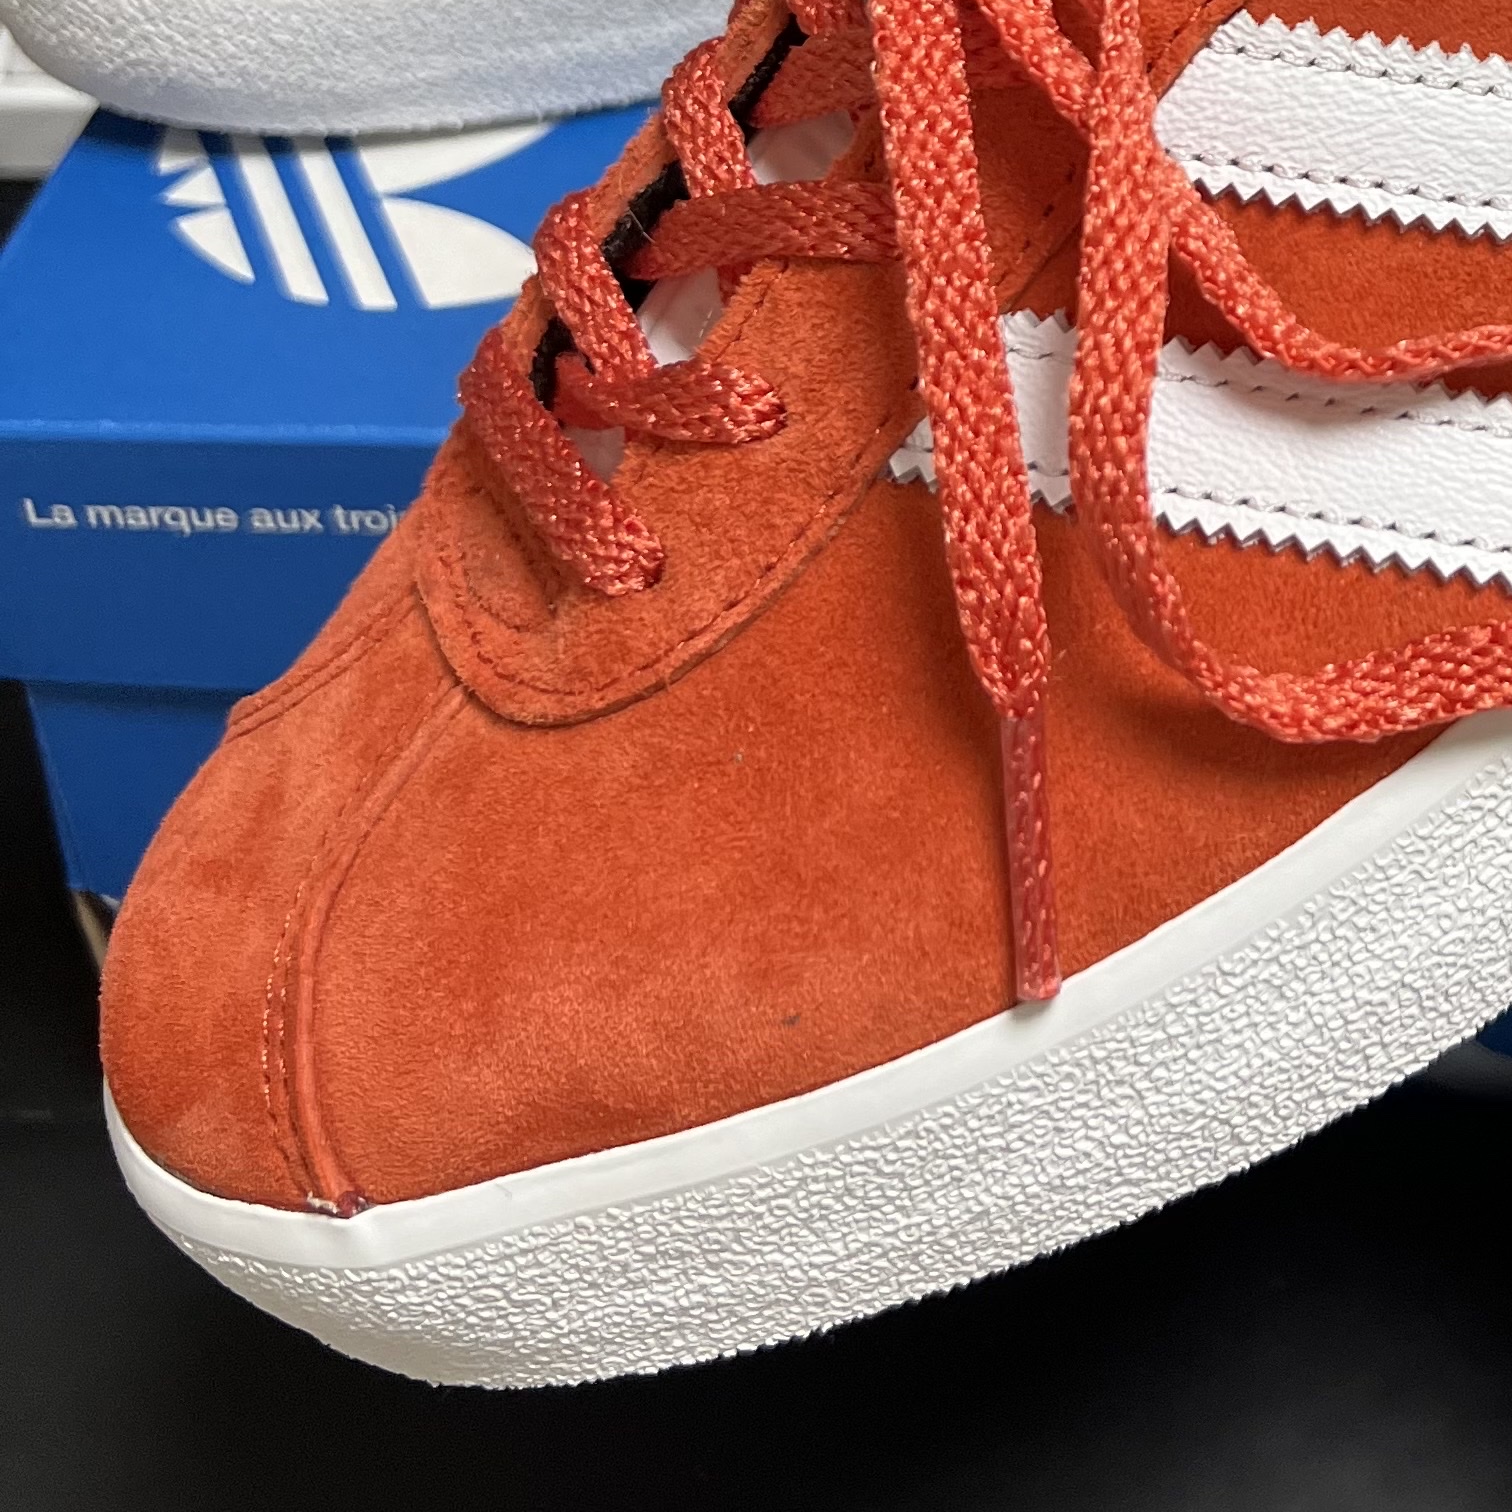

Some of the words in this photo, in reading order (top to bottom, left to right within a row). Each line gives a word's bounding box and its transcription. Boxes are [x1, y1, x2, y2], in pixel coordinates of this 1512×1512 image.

[22, 497, 77, 529] La
[86, 503, 239, 537] marque
[249, 505, 325, 533] aux
[331, 503, 406, 536] troi
